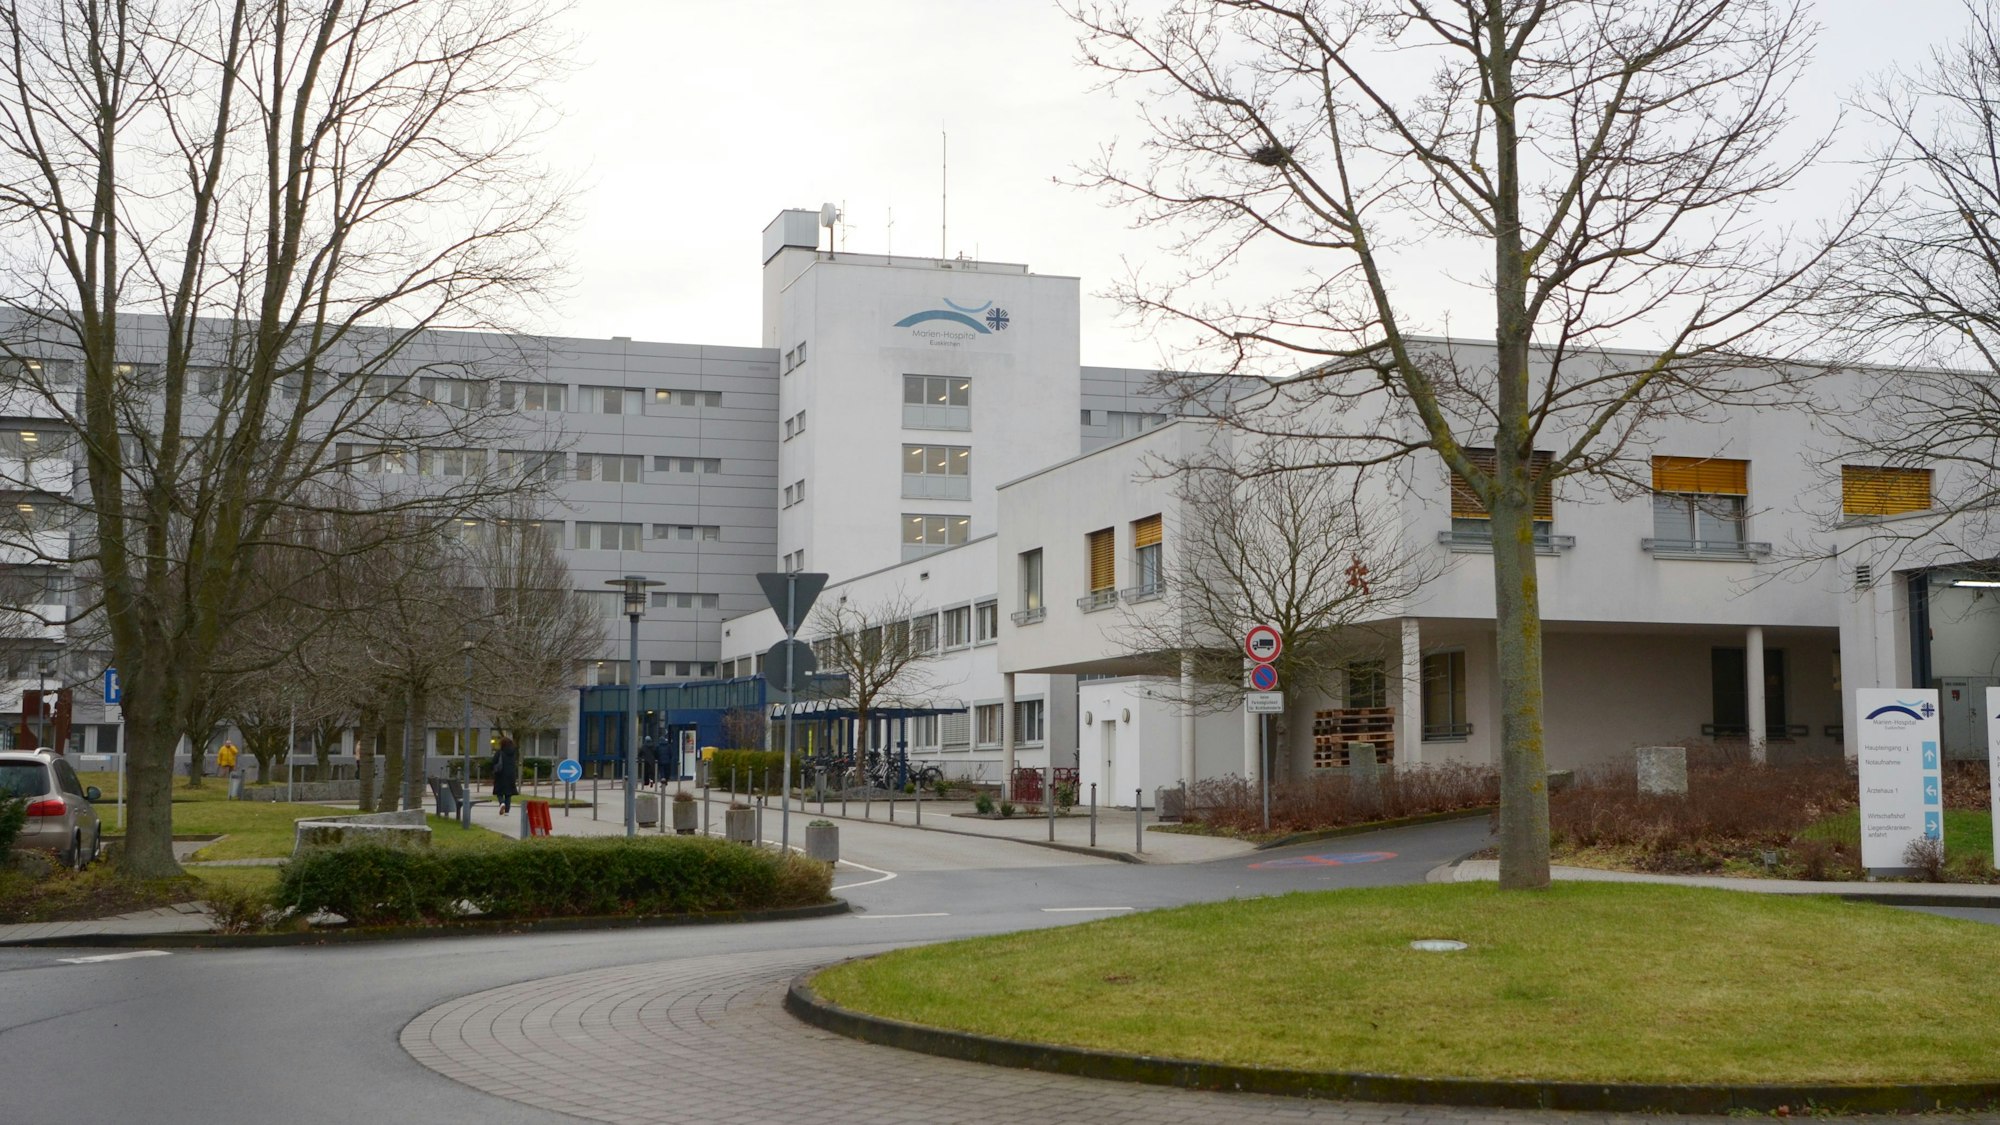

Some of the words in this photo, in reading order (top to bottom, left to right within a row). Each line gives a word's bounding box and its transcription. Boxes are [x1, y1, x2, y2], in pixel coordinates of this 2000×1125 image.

[912, 330, 976, 340] Marien-Hospital
[1864, 744, 1902, 752] Haupteingang
[1867, 812, 1906, 820] Wirtschaftshof
